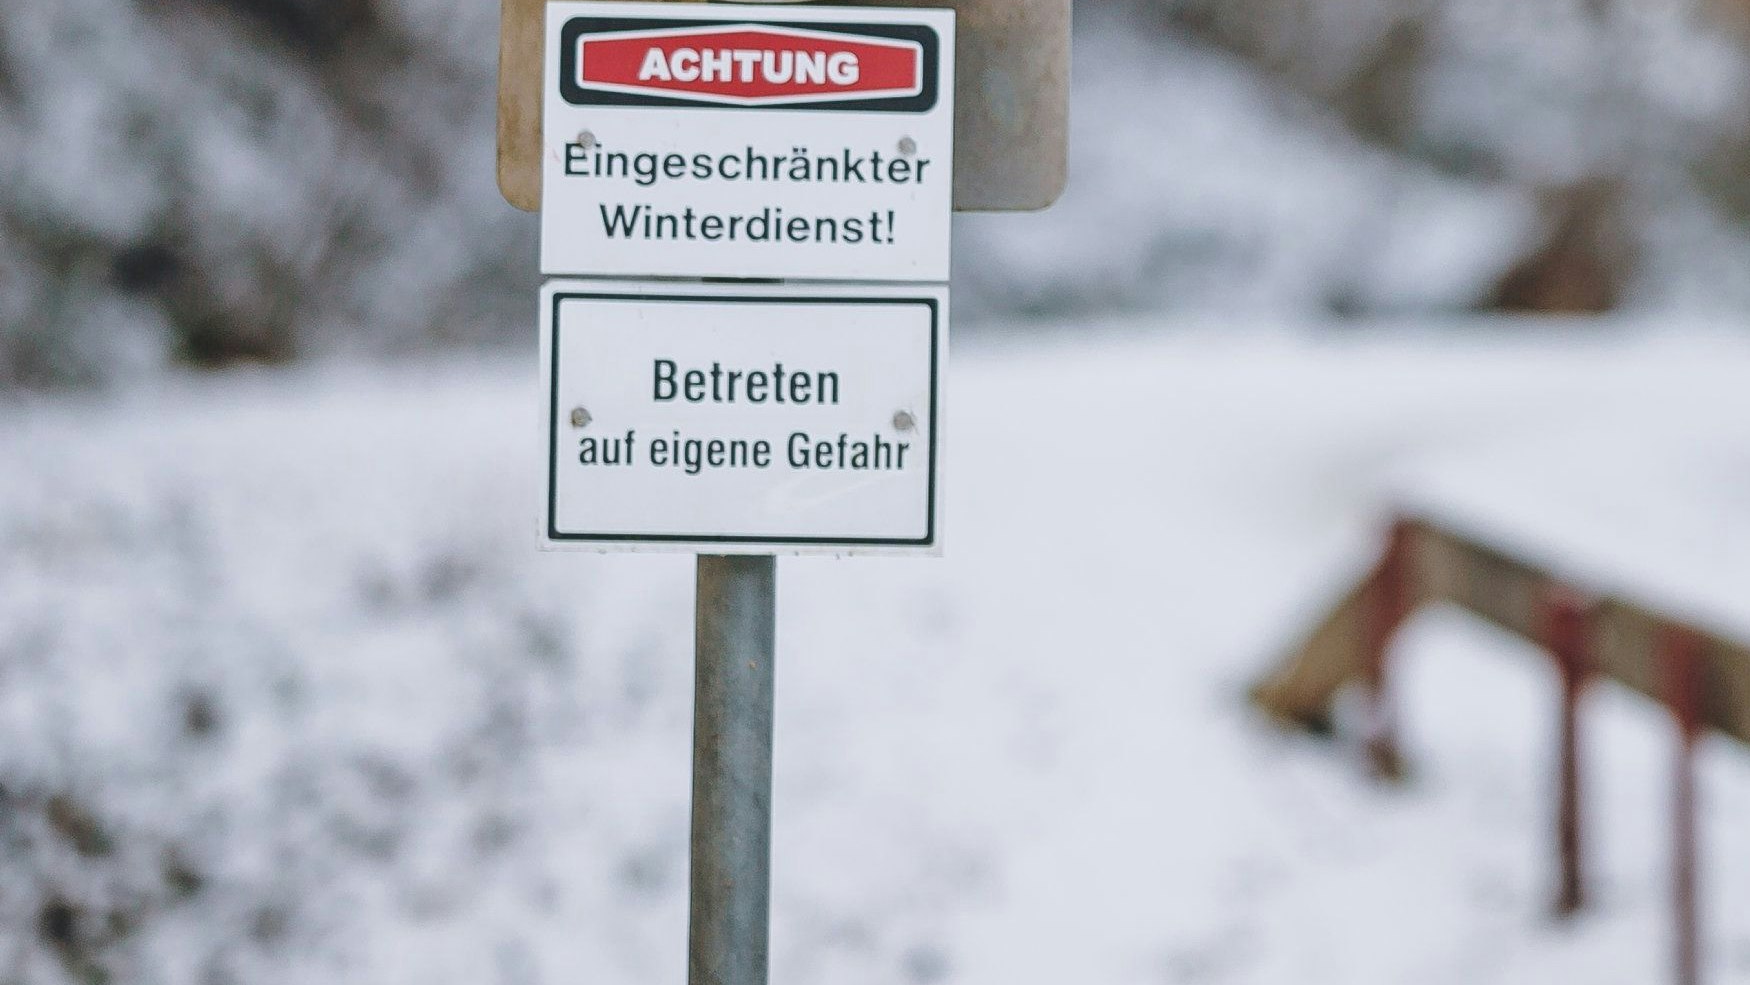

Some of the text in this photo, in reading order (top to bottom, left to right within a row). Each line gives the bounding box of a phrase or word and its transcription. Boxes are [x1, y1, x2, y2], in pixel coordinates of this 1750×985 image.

[638, 47, 860, 85] ACHTUNG
[563, 141, 931, 186] Eingeschränkter
[599, 203, 896, 244] Winterdienst!
[653, 359, 840, 404] Betreten
[578, 430, 910, 474] auf eigene Gefahr
